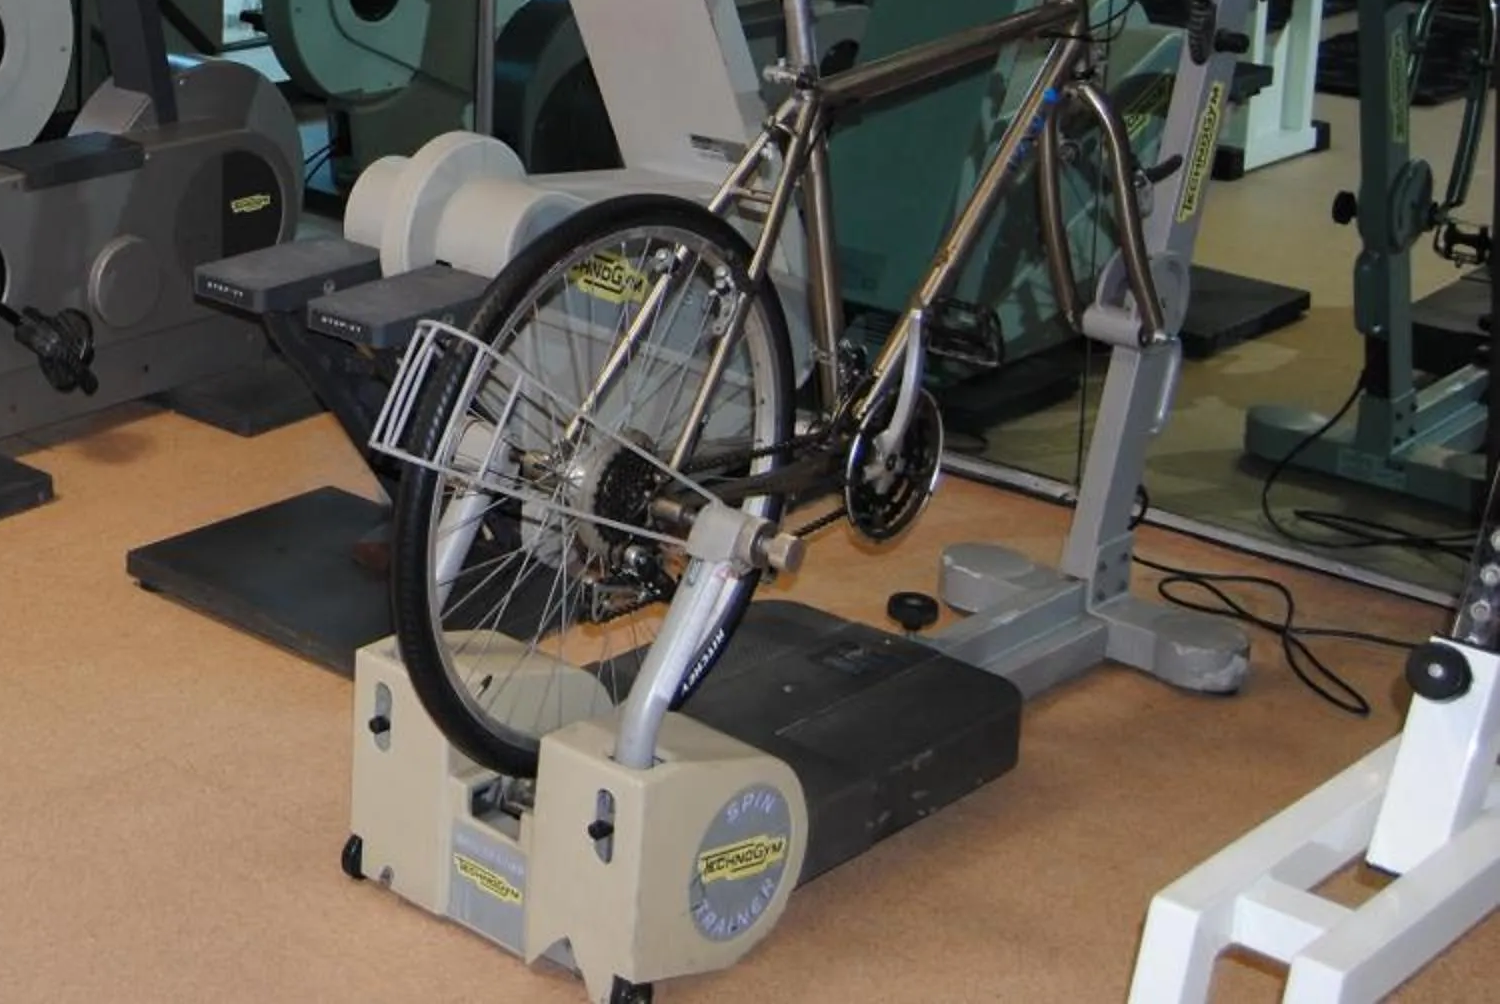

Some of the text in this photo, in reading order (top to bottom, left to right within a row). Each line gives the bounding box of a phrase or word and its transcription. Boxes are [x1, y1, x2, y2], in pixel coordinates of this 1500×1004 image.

[725, 793, 776, 824] SPIN
[701, 839, 785, 875] TECHNOGYM
[694, 877, 775, 934] TRAINER
